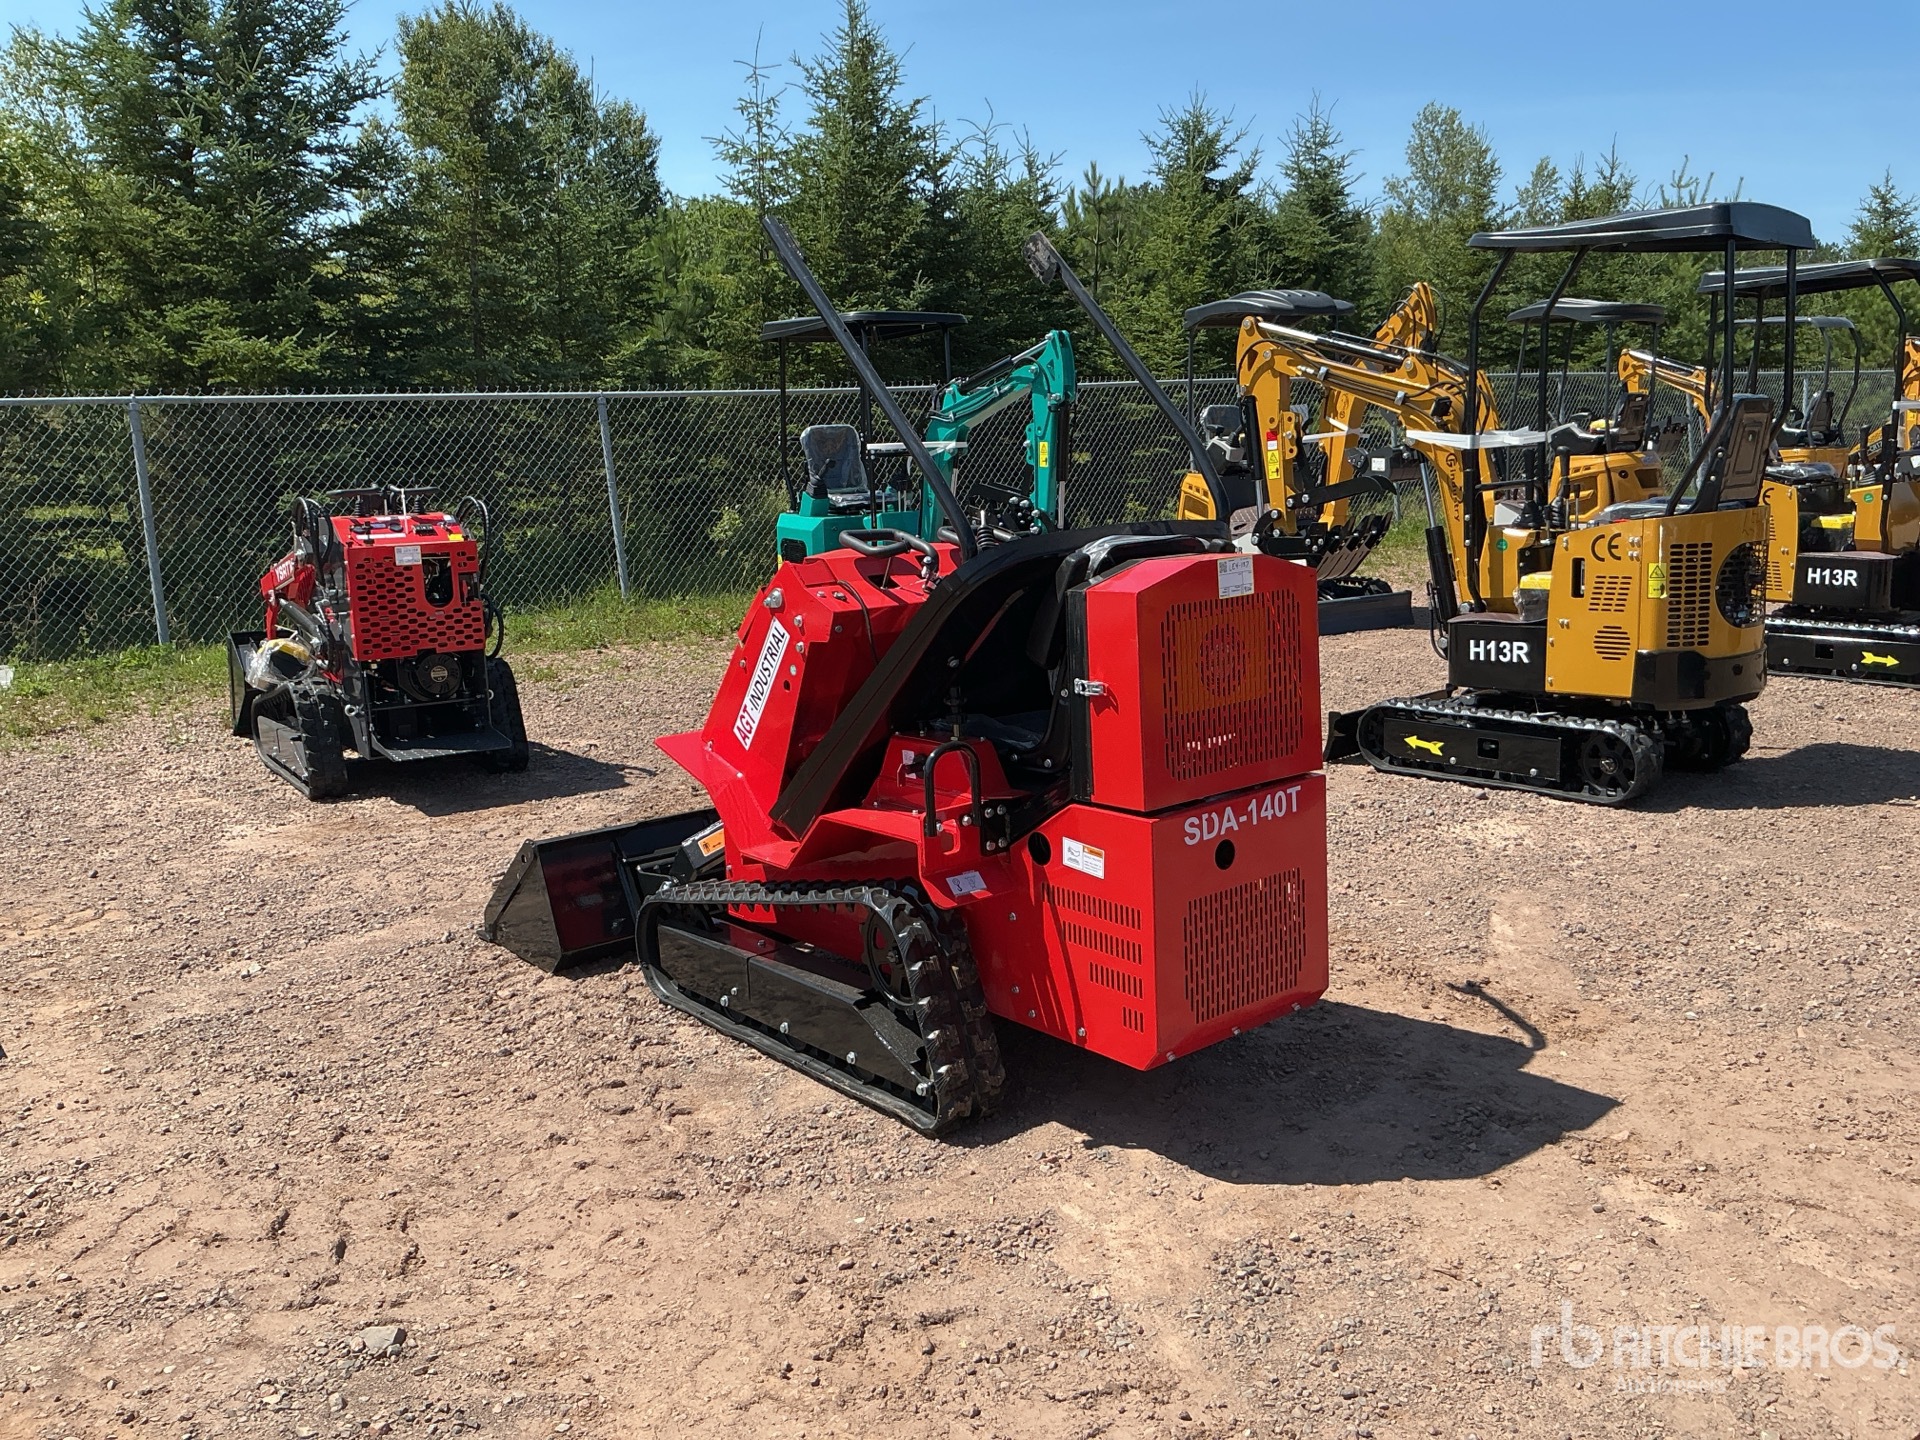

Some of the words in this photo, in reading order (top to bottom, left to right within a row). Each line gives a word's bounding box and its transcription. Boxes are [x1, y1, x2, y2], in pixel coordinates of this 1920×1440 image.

[1590, 532, 1622, 563] CE
[1806, 567, 1858, 587] H13R
[1468, 639, 1531, 664] H13R
[735, 704, 756, 747] AGT
[749, 626, 786, 710] INDUSTRIAL
[1183, 785, 1302, 847] SDA-140T
